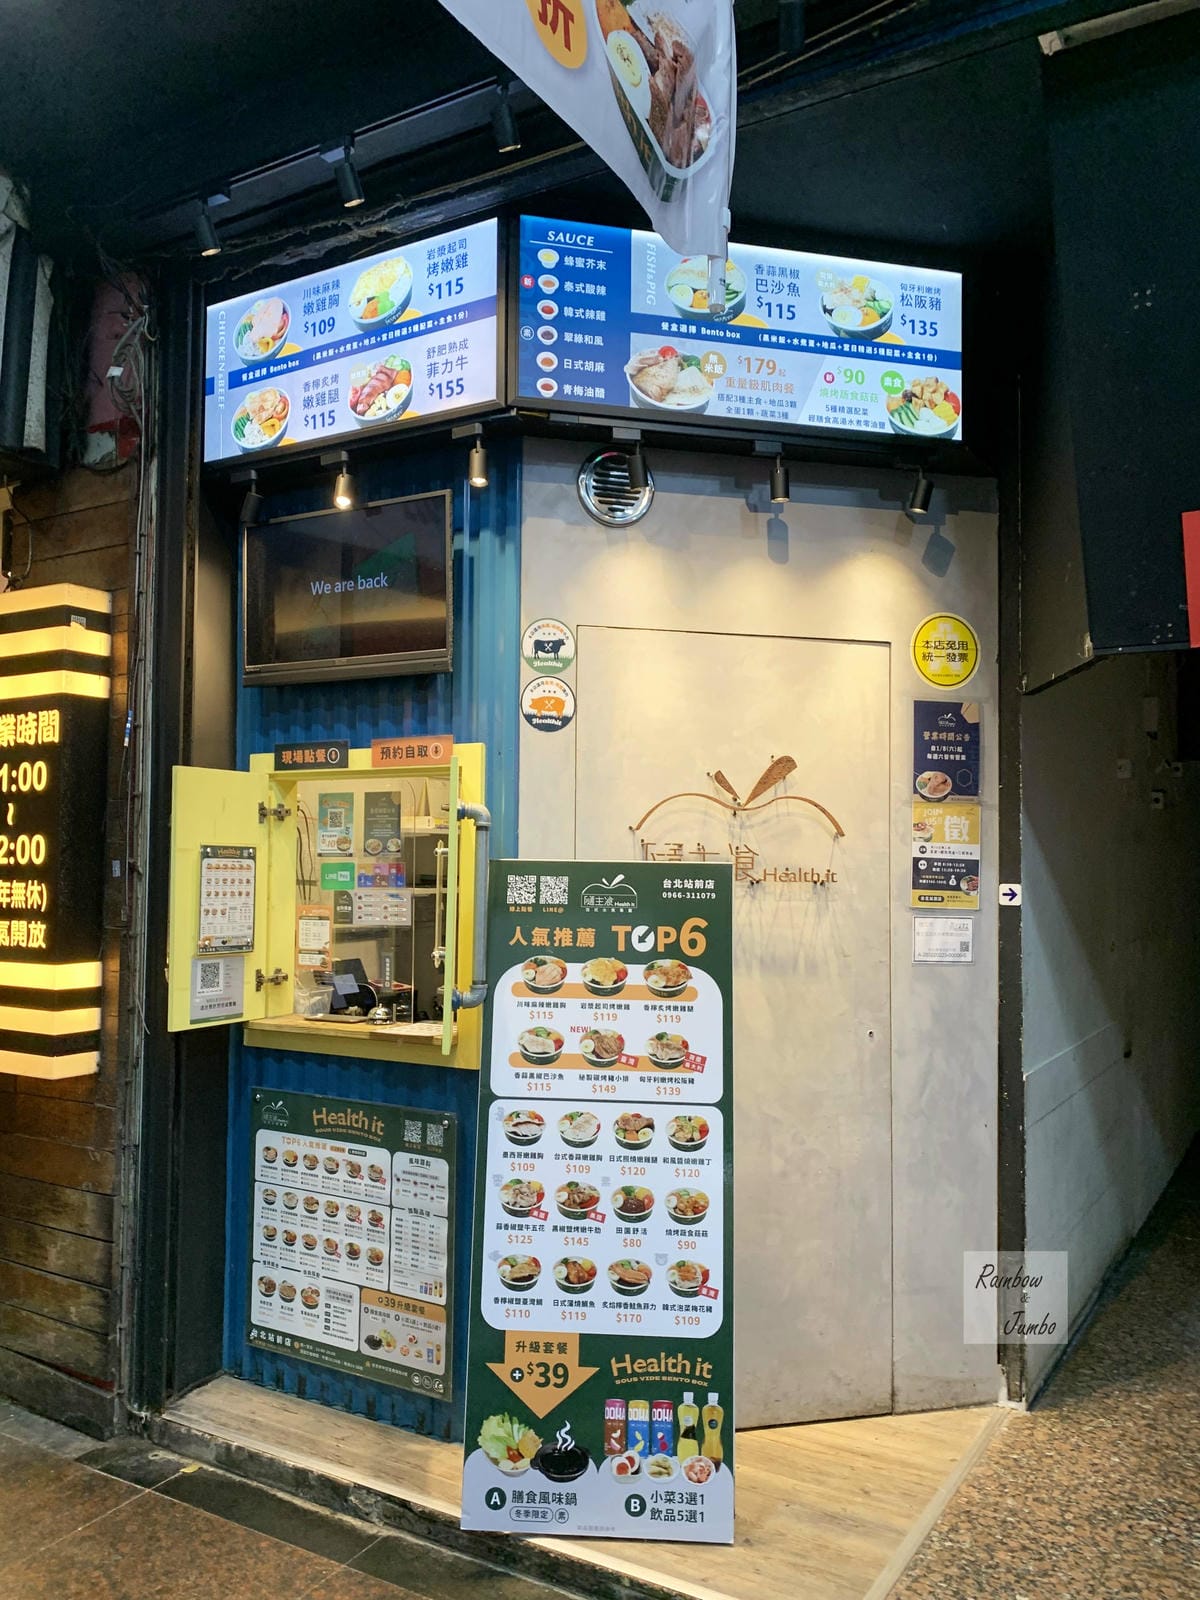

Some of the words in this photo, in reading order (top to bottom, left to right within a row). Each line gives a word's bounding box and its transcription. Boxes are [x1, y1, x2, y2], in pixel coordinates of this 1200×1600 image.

[547, 230, 595, 247] SAUCE
[427, 238, 467, 260] 岩漿起司
[427, 252, 468, 278] 烤嫩雞
[563, 255, 607, 270] 蜂蜜芥末
[646, 242, 656, 306] FISH&PIG
[755, 264, 800, 280] 香蒜黑椒
[303, 279, 340, 300] 川味麻辣
[428, 277, 464, 300] $115
[563, 281, 607, 297] 泰式酸辣
[755, 278, 801, 298] 巴沙魚
[303, 294, 339, 316] 嫩雞胸
[757, 296, 796, 321] $115
[900, 293, 942, 311] 松阪豬
[304, 316, 336, 337] $109
[701, 327, 725, 337] Bento
[726, 329, 741, 339] box
[900, 313, 938, 337] $135
[564, 332, 604, 346] 翠綠和風
[427, 338, 469, 359] 舒肥熟成
[427, 355, 469, 379] 菲力牛
[563, 358, 606, 373] 日式胡麻
[837, 366, 865, 386] $90
[428, 377, 465, 400] $155
[563, 383, 606, 399] 青梅油醋
[725, 376, 795, 394] 重量級肌肉餐
[303, 388, 340, 410] 嫩雞腿
[304, 409, 336, 430] $115
[310, 580, 332, 597] We
[334, 579, 354, 593] are
[357, 572, 388, 590] back
[922, 652, 969, 663] 統一發票
[281, 748, 327, 765] 現場點餐
[380, 744, 428, 761] 預約自取
[762, 867, 820, 883] Health
[825, 869, 838, 883] it
[663, 878, 715, 889] 台北站前店
[509, 926, 596, 948] 人氣推薦
[611, 917, 708, 957] TOP6
[529, 1010, 554, 1020] $115
[593, 1012, 618, 1021] $119
[656, 1014, 681, 1023] $119
[527, 1082, 552, 1092] $115
[592, 1084, 616, 1094] $149
[656, 1086, 681, 1096] $139
[312, 1107, 369, 1131] Health
[372, 1115, 385, 1136] it
[510, 1162, 535, 1172] $109
[565, 1164, 591, 1174] $109
[620, 1166, 646, 1176] $120
[674, 1168, 700, 1178] $120
[507, 1234, 533, 1244] $125
[563, 1236, 589, 1246] $145
[623, 1238, 642, 1248] $80
[677, 1240, 697, 1250] $90
[505, 1308, 531, 1319] $110
[561, 1310, 587, 1320] $119
[616, 1312, 642, 1323] $170
[674, 1315, 701, 1325] $109
[515, 1341, 568, 1355] 升級套餐
[610, 1352, 691, 1377] Health
[695, 1357, 713, 1379] it
[490, 1491, 501, 1505] A
[511, 1490, 578, 1506] 膳食風味鍋
[630, 1499, 641, 1512] B
[650, 1490, 705, 1505] 小菜3選1
[514, 1509, 549, 1519] 冬季限定
[650, 1507, 705, 1523] 飲品5選1
